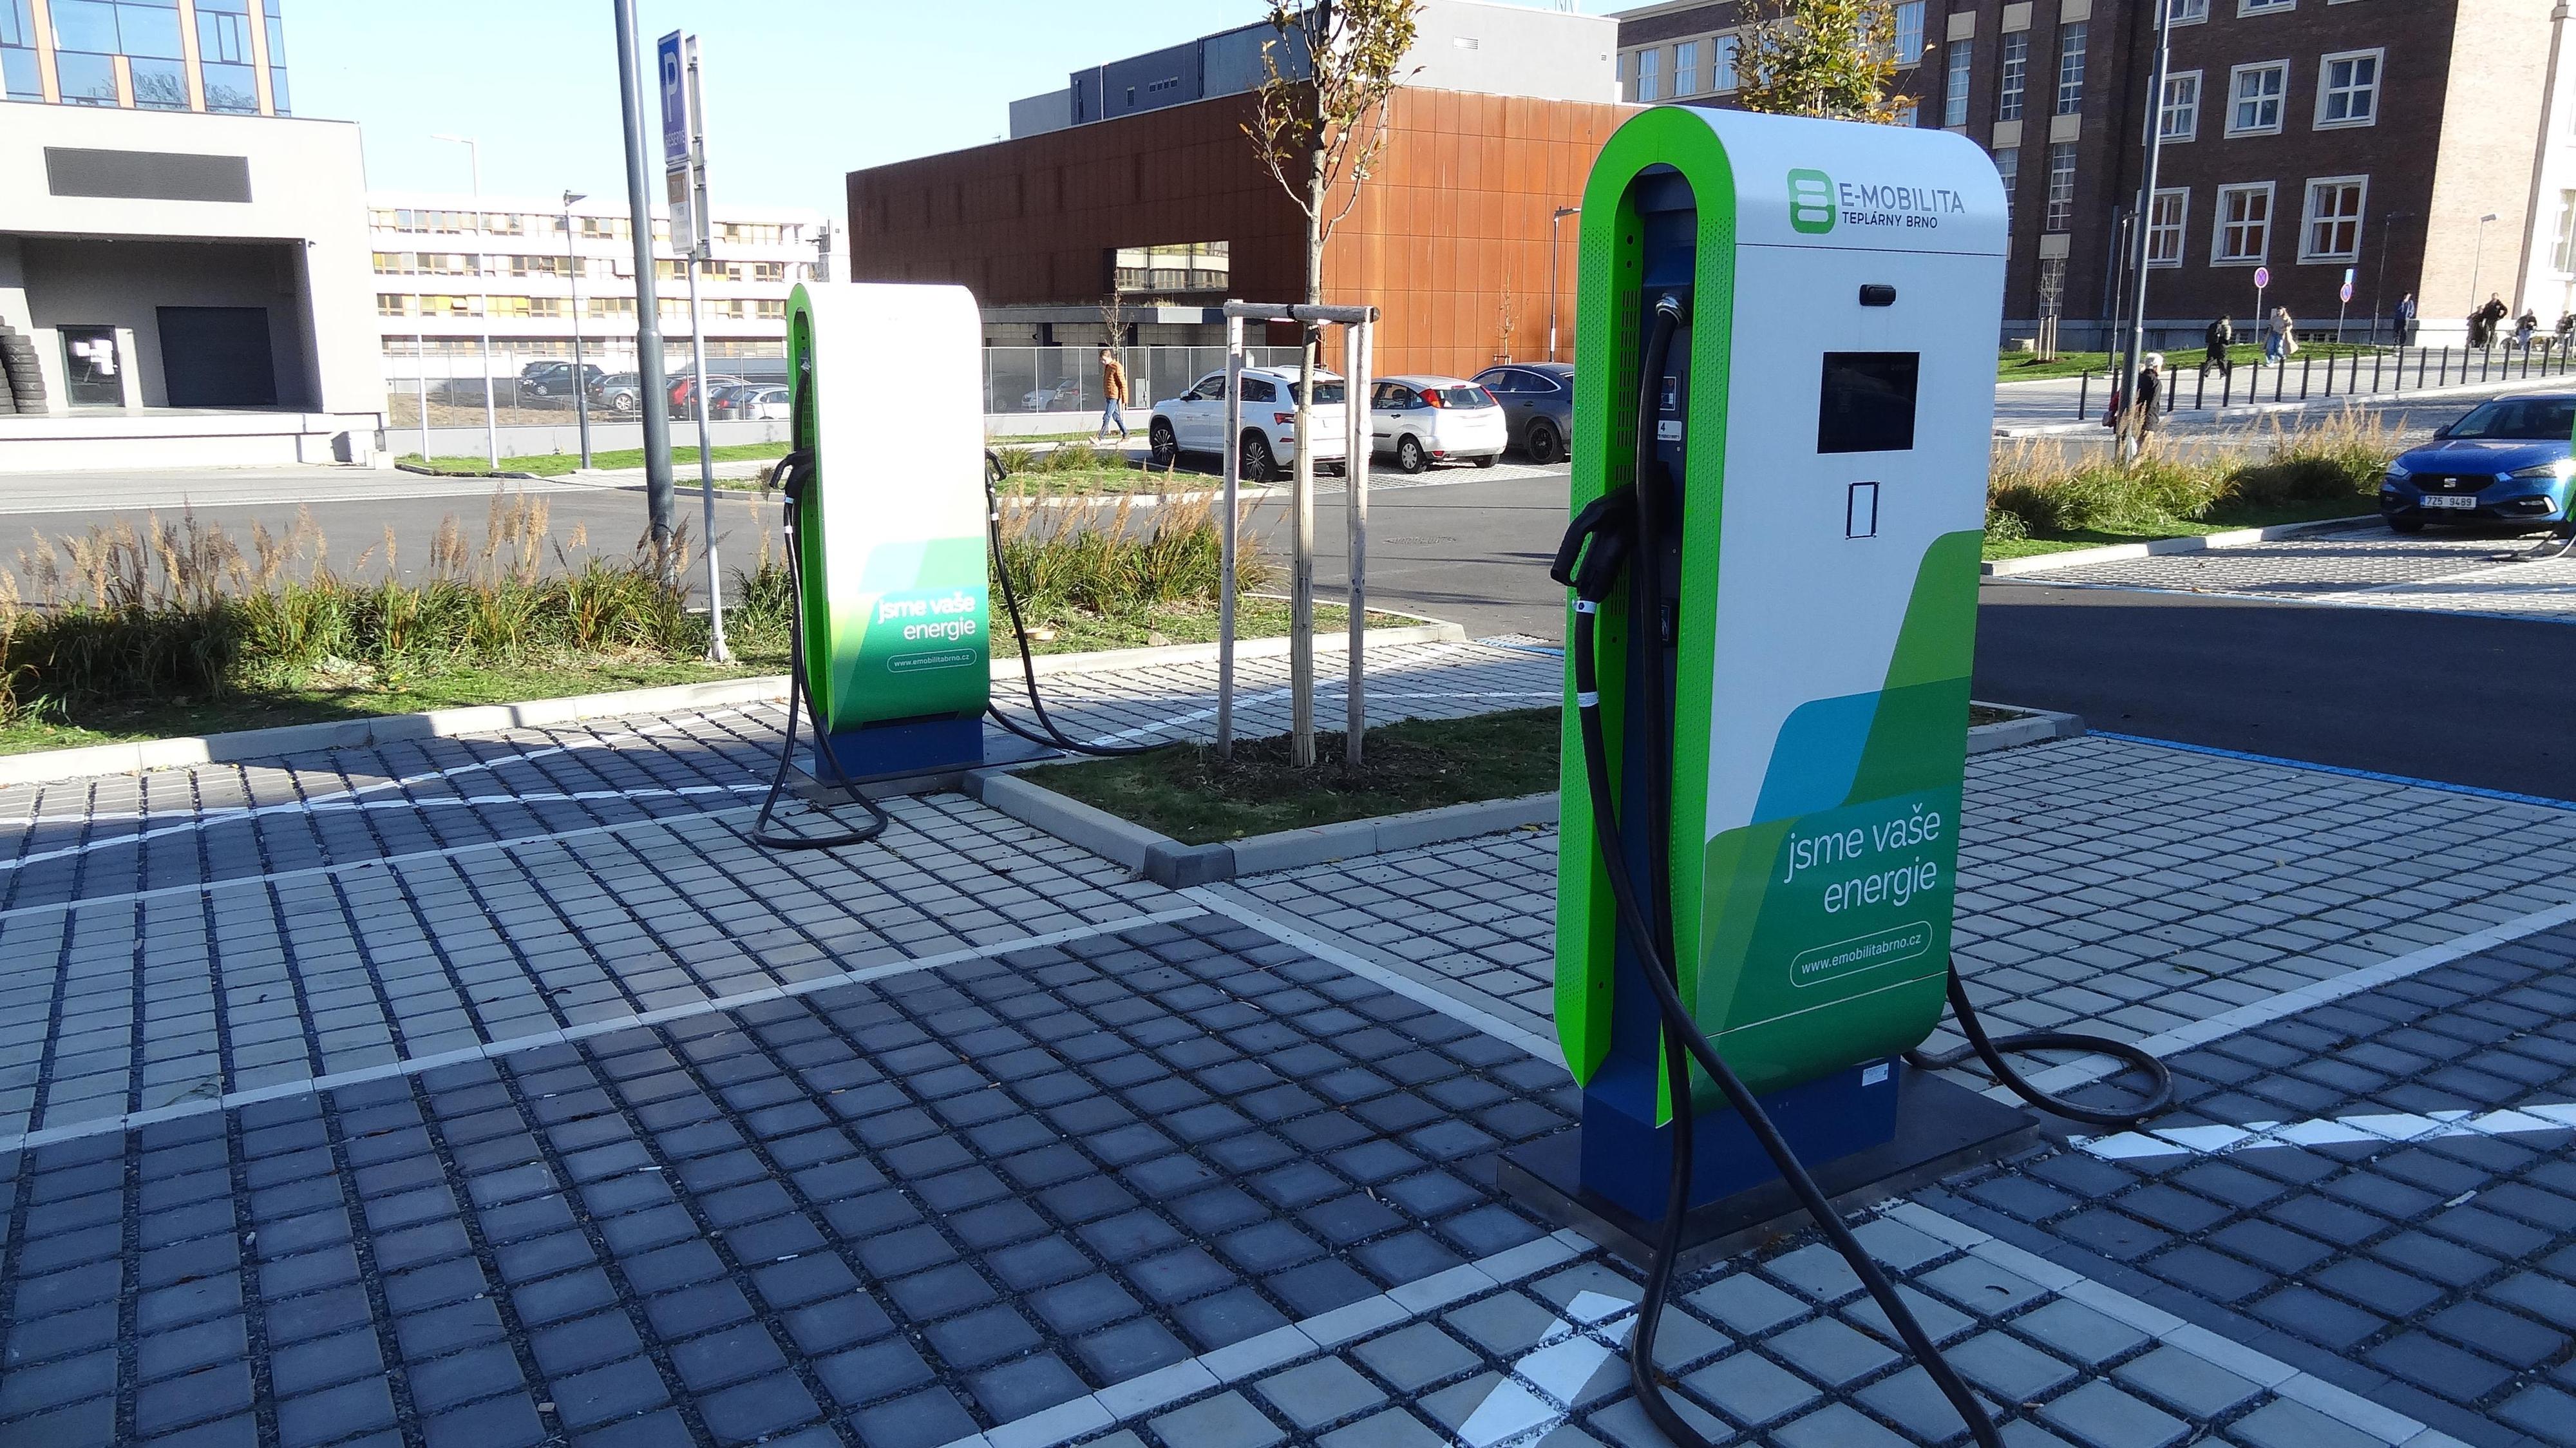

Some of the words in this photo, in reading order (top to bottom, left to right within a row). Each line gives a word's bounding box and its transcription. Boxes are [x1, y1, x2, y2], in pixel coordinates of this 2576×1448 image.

[664, 52, 678, 123] P
[1839, 182, 1965, 214] E-MOBILITA
[1842, 211, 1902, 227] TEPLÁRNY
[1906, 214, 1938, 229] BRNO
[877, 599, 927, 624] jsme
[929, 591, 976, 614] vaše
[904, 616, 976, 641] energie
[894, 654, 970, 667] www.emobilitabrno.cz
[1783, 828, 1864, 884] jsme
[1872, 803, 1940, 852] vaše
[1823, 856, 1938, 914] energie
[1801, 933, 1922, 975] www.emobilitabrno.cz
